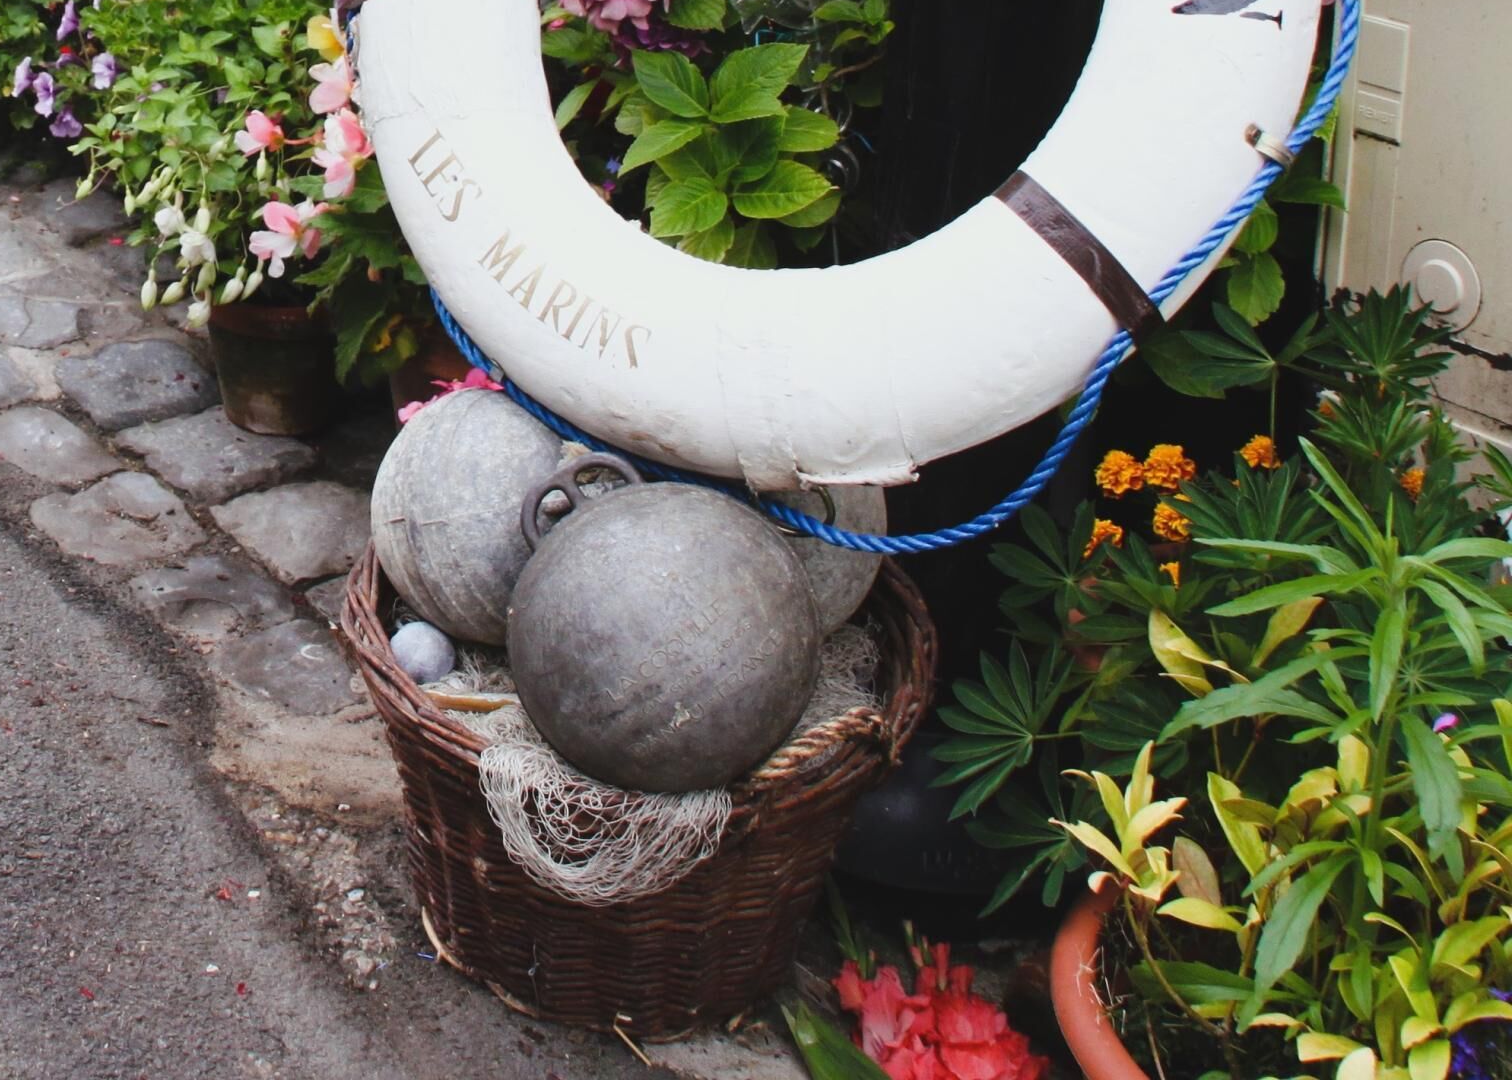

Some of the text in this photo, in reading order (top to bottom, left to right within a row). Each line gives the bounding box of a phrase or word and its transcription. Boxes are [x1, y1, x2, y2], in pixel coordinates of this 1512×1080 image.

[407, 128, 652, 370] LES MARINS
[605, 675, 638, 705] LA
[639, 599, 728, 678] COQUILLE
